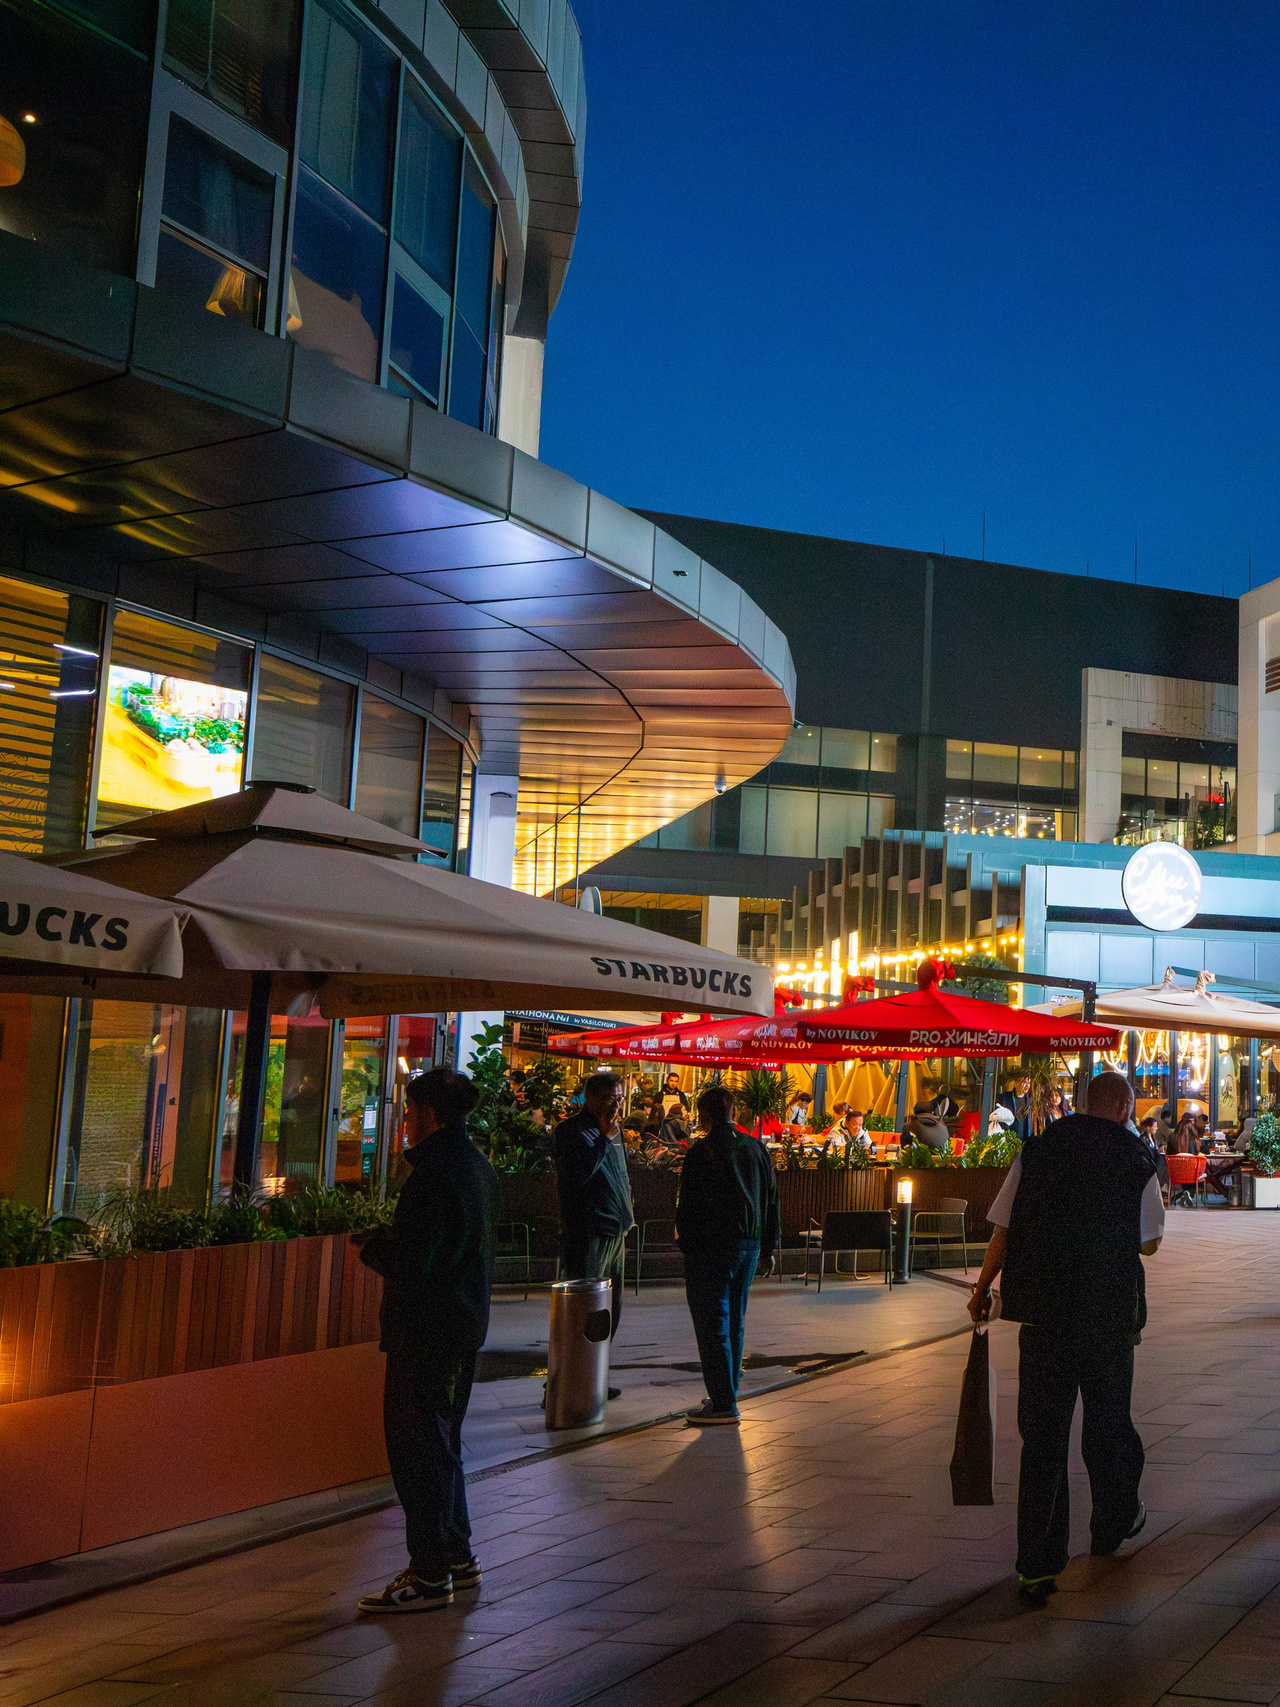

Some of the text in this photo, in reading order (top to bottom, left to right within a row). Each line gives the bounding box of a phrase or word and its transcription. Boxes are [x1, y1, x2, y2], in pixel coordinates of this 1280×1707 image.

[0, 901, 130, 952] UCKS
[590, 956, 752, 998] STARBUCKS
[580, 1018, 617, 1029] VASILCHUKI
[806, 1028, 816, 1038] by
[817, 1028, 879, 1041] NOVIKOV
[1050, 1036, 1114, 1047] by NOVIKOV
